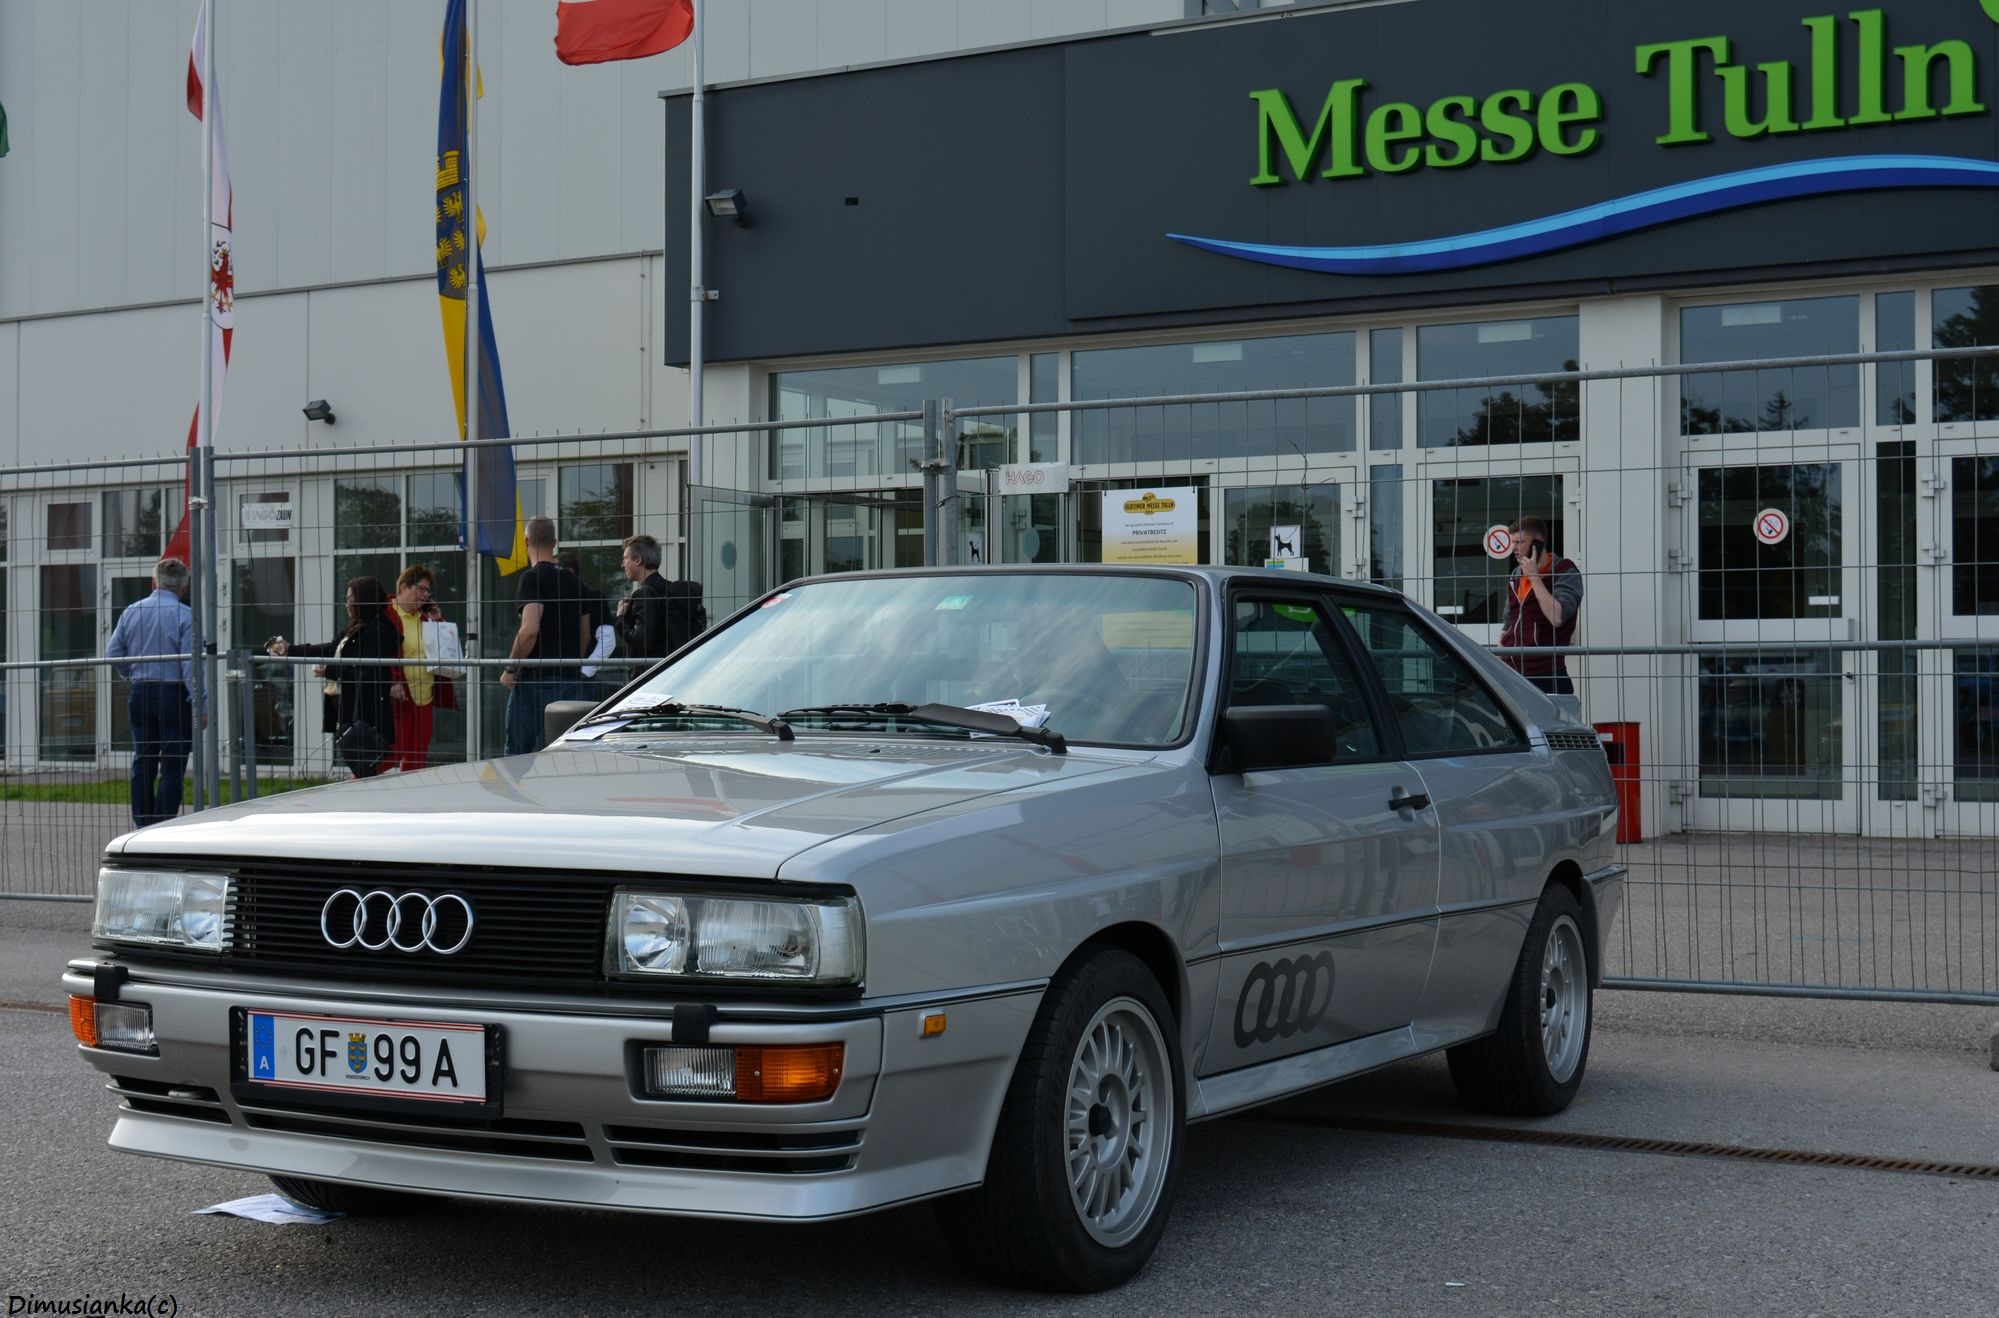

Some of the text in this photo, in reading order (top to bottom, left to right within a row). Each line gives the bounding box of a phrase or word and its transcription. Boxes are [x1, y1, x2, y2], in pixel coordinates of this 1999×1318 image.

[1249, 7, 1986, 188] Messe Tulln
[1006, 470, 1044, 485] HAGO
[259, 1055, 270, 1071] A
[295, 1027, 459, 1088] GF 99 A
